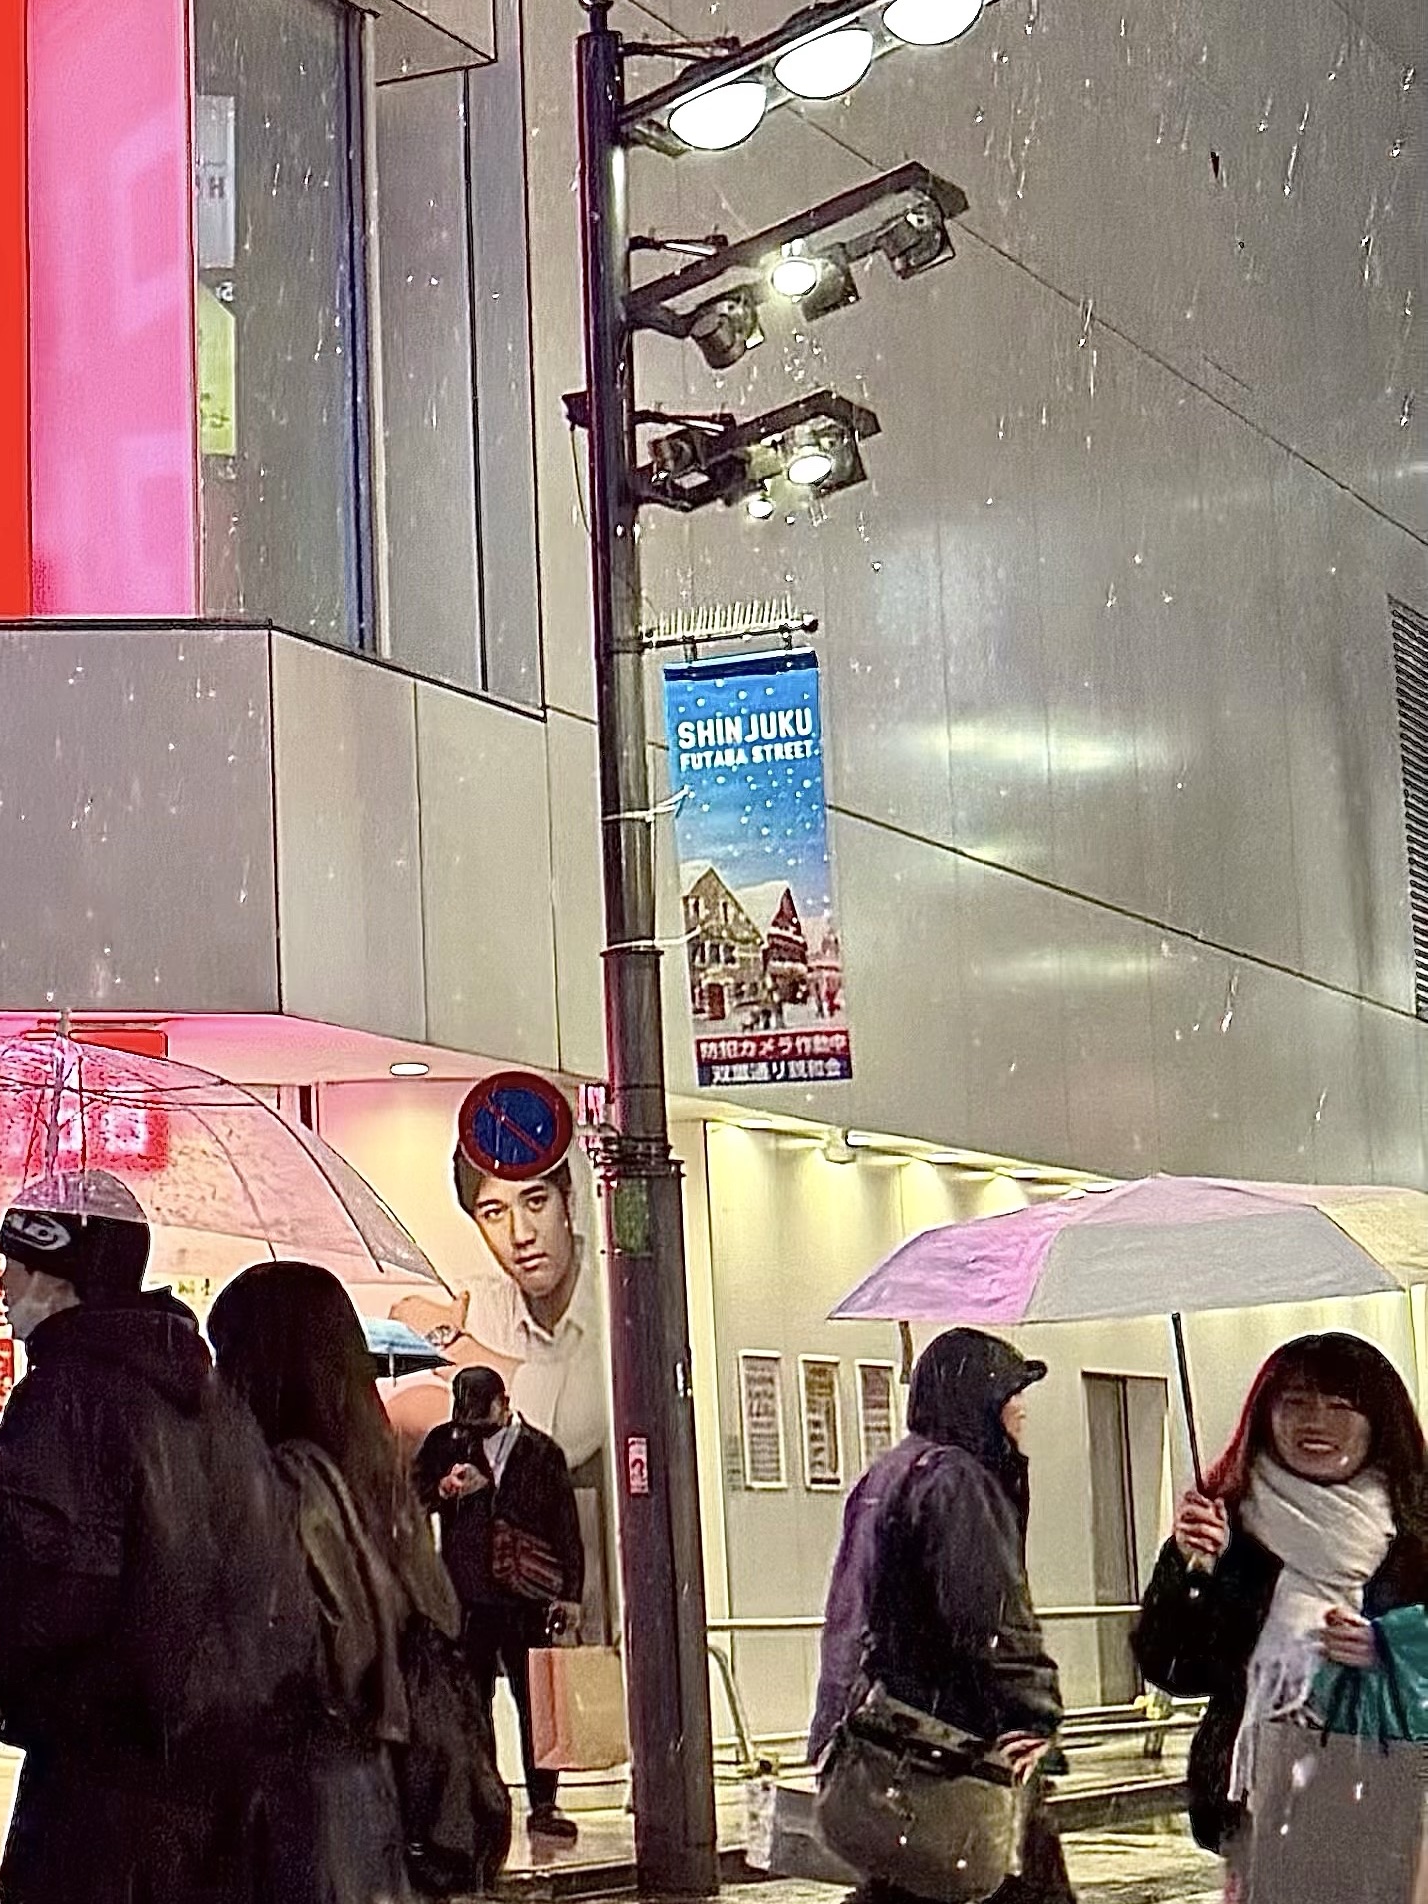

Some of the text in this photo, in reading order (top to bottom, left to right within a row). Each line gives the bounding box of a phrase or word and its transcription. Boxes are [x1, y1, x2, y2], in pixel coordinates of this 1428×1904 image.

[677, 707, 813, 750] SHINJUKU
[680, 739, 814, 773] FUTABA STREET
